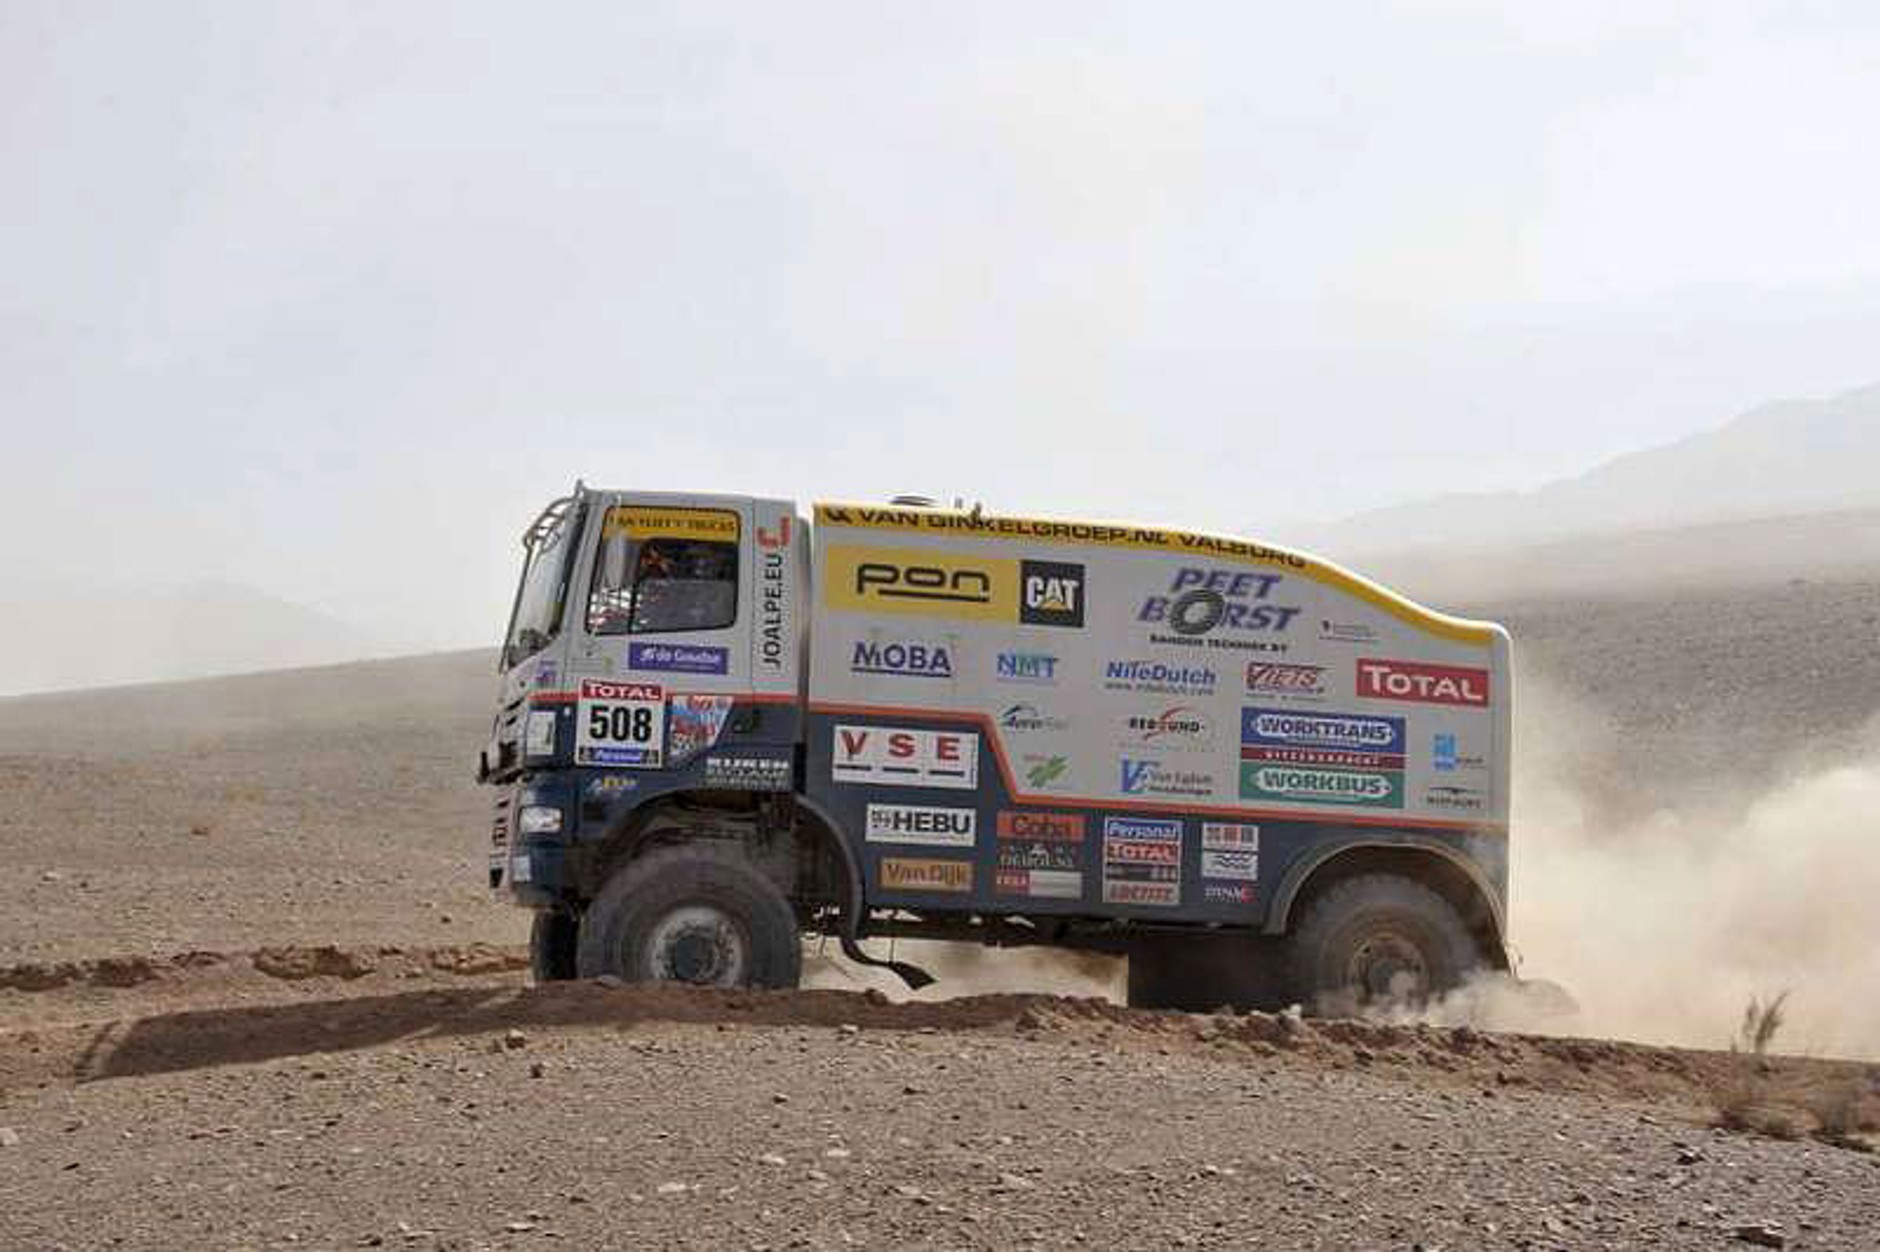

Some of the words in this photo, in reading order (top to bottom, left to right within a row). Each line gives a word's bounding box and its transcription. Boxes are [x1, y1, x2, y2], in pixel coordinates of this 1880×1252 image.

[860, 508, 919, 528] VAN
[1026, 576, 1079, 610] CAT
[1169, 567, 1282, 599] PEET
[762, 552, 785, 669] JOALPE.EU
[853, 641, 952, 672] MOBA
[1106, 661, 1216, 687] NileDutch
[1362, 665, 1484, 701] TOTAL
[587, 681, 660, 700] TOTAL
[588, 705, 653, 742] 508
[1259, 717, 1388, 741] WORKTRANS
[1263, 769, 1382, 796] WORKBUS
[892, 810, 971, 835] HEBU
[1107, 843, 1178, 862] TOTAL
